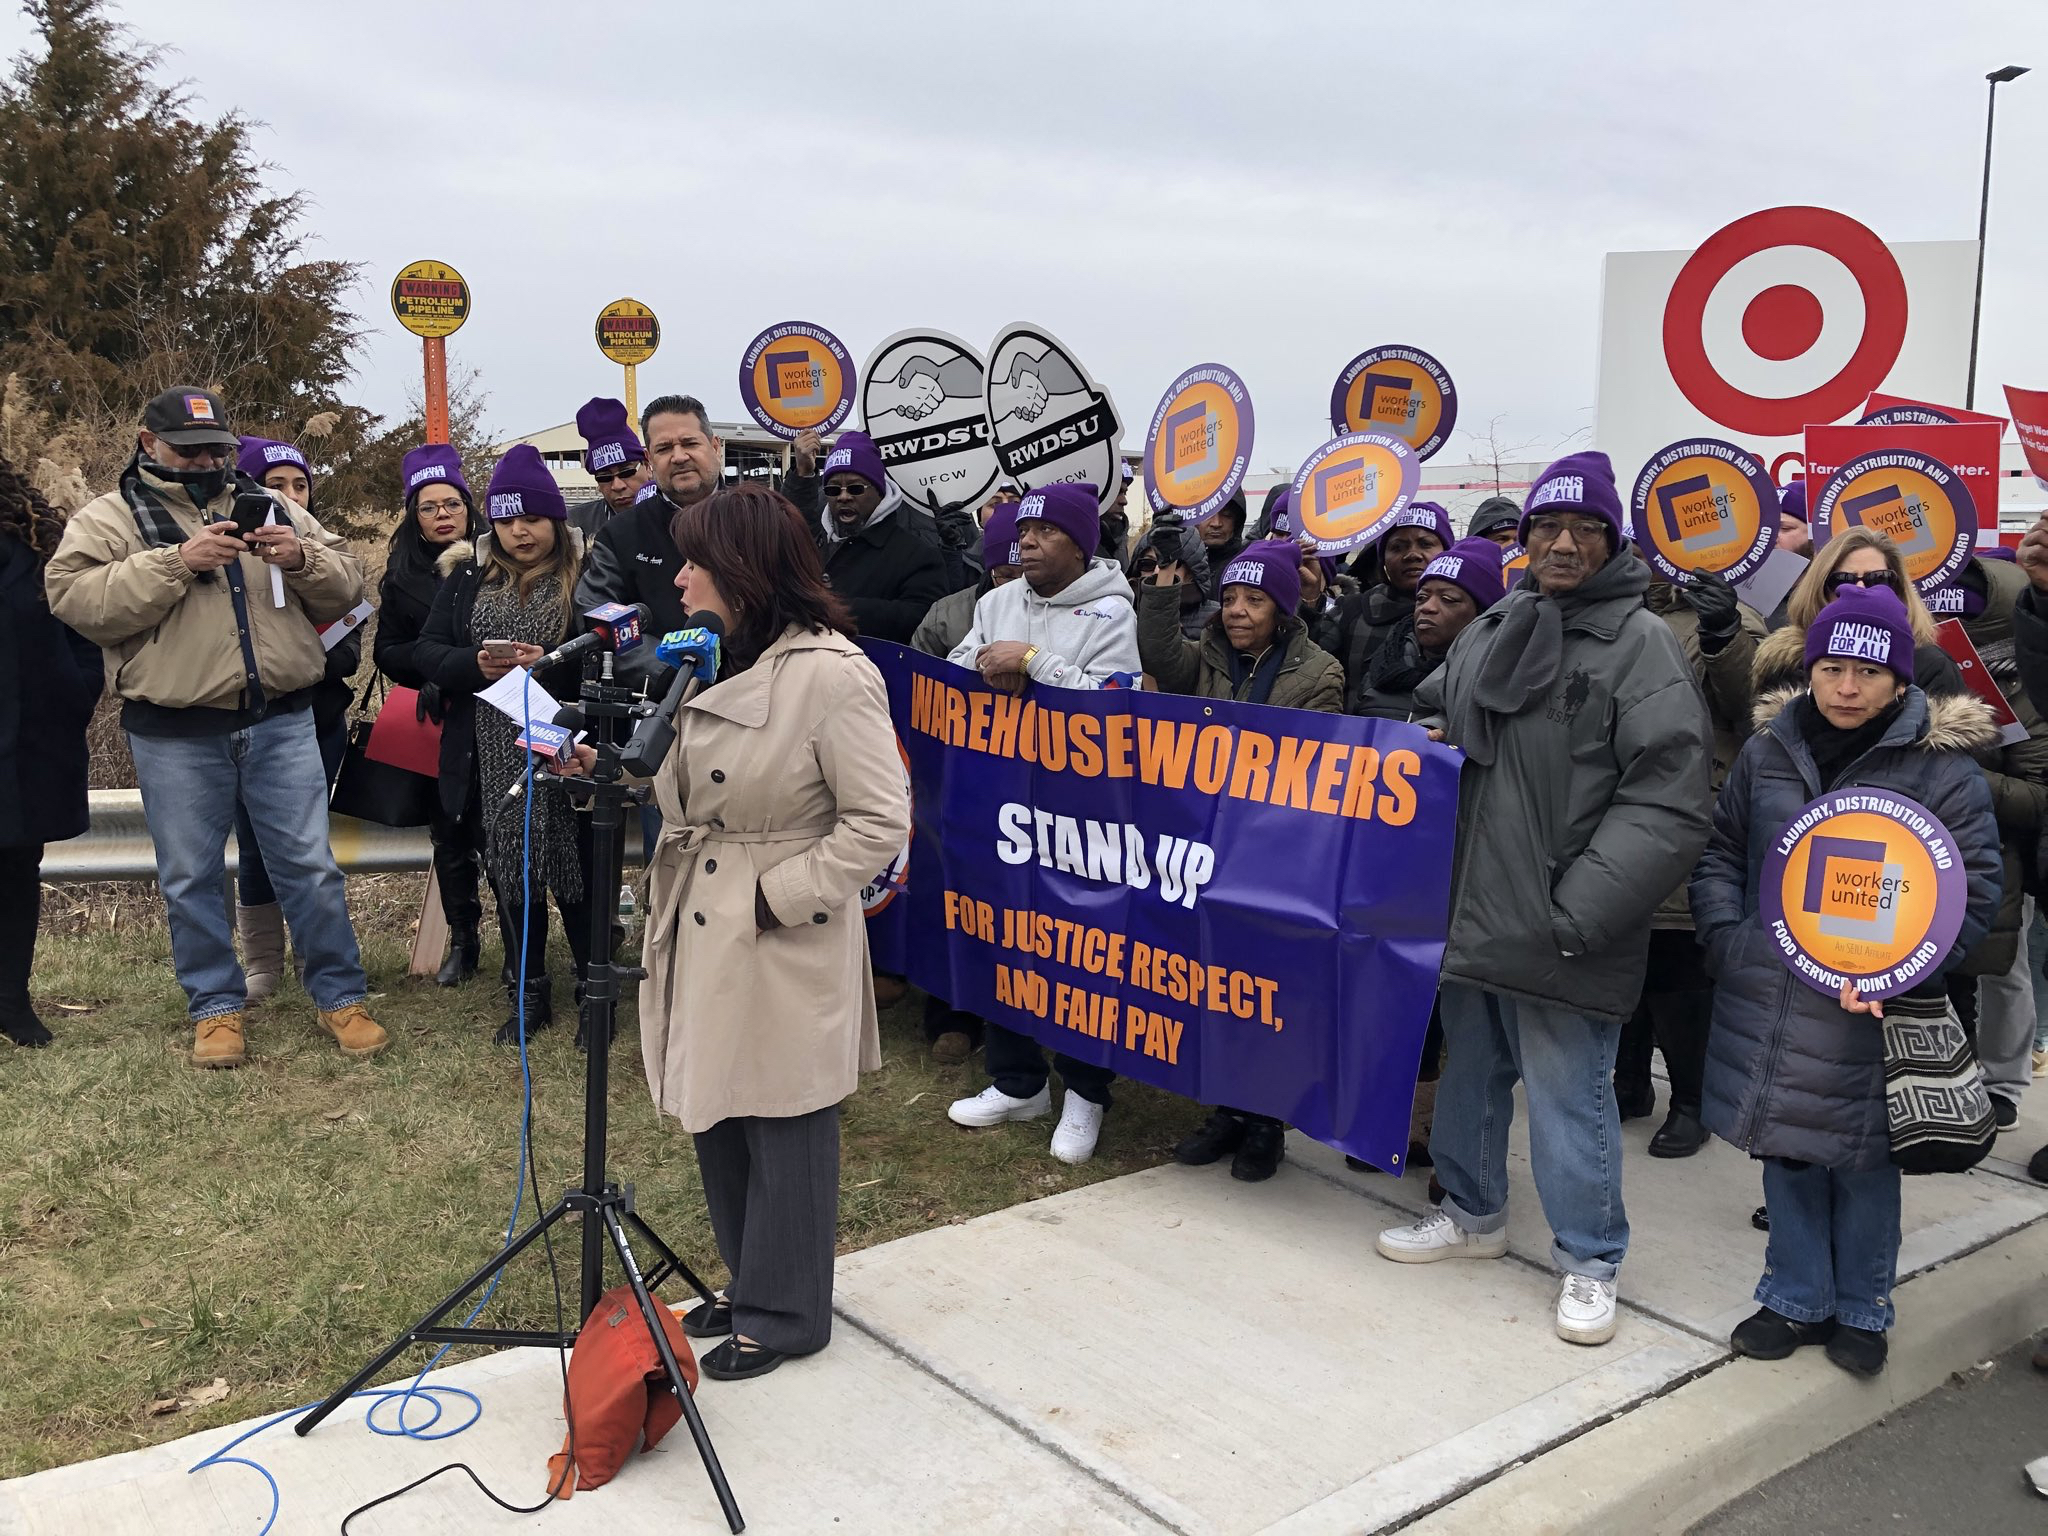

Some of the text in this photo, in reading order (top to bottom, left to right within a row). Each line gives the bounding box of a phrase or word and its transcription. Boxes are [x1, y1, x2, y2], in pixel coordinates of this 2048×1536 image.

[405, 282, 458, 296] WARNING
[399, 296, 463, 307] PETROLEUM
[408, 305, 455, 315] PIPELINE
[603, 331, 653, 339] PETROLEUM
[604, 319, 653, 330] WARNING
[745, 325, 845, 370] LAUNDRY, DISTRIBUTION AND
[784, 367, 828, 380] workers
[784, 377, 820, 390] united
[1343, 349, 1451, 396] LAUNDRY, DISTRIBUTION AND
[1150, 369, 1244, 442] LAUNDRY, DISTRIBUTION AND
[1377, 405, 1416, 418] united
[1380, 394, 1427, 409] workers
[753, 406, 775, 427] FOOD
[772, 422, 804, 437] SERVIC
[812, 420, 831, 434] OINT
[828, 398, 849, 425] BOARD
[879, 421, 988, 461] RWDSU
[1007, 414, 1101, 469] RWDSU
[1180, 418, 1223, 444] workers
[593, 442, 622, 459] UNIONS
[1179, 433, 1215, 458] united
[266, 451, 283, 463] FOR
[607, 450, 626, 464] ALL
[1293, 434, 1408, 495] LAUNDRY, DISTRIBUTION AND
[918, 468, 967, 487] UFCW
[1046, 469, 1088, 487] FCW
[1172, 507, 1197, 520] RVICE
[1198, 491, 1223, 516] JOINT
[1222, 455, 1245, 495] BOARD
[1333, 469, 1385, 491] workers
[1538, 475, 1584, 494] UNIONS
[1636, 460, 1663, 510] LAUNDRY,
[1660, 444, 1736, 467] DISTRIBUTION
[1733, 455, 1758, 477] AND
[490, 492, 522, 506] UNIONS
[1332, 480, 1375, 502] united
[1553, 486, 1583, 502] ALL
[1818, 476, 1849, 526] LAUNDRY,
[1845, 454, 1926, 481] DISTRIBUTION
[1924, 464, 1950, 486] AND
[491, 501, 525, 517] FOR ALL
[1023, 504, 1044, 517] ALL
[1681, 491, 1737, 516] workers
[1871, 499, 1931, 527] workers
[1316, 538, 1353, 551] SERVICE
[1354, 522, 1382, 544] JOINT
[1381, 494, 1408, 525] BOARD
[1416, 516, 1437, 530] ALL
[1684, 505, 1729, 528] united
[1884, 514, 1923, 536] nited
[1653, 553, 1677, 577] FOOD
[1723, 559, 1752, 582] JOINT
[1748, 525, 1772, 563] BOARD
[1921, 566, 1951, 592] JOINT
[1950, 532, 1970, 570] BOARD
[1227, 560, 1265, 572] UNIONS
[1436, 563, 1461, 579] ALL
[1223, 570, 1263, 585] FOR ALL
[1938, 599, 1963, 612] ALL
[620, 627, 632, 641] 5
[631, 620, 640, 639] FOX
[1832, 621, 1892, 646] UNIONS
[1830, 636, 1889, 662] FOR ALL
[1777, 795, 1953, 870] LAUNDRY, DISTRIBUTION AND
[996, 802, 1216, 910] STAND UP
[1835, 871, 1911, 894] workers
[1831, 888, 1893, 910] united
[943, 889, 995, 945] FOR
[1130, 940, 1284, 1033] RESPECT,
[1771, 919, 1797, 956] FOOD
[1893, 940, 1938, 984] BOARD
[995, 963, 1184, 1066] AND FAIR PAY
